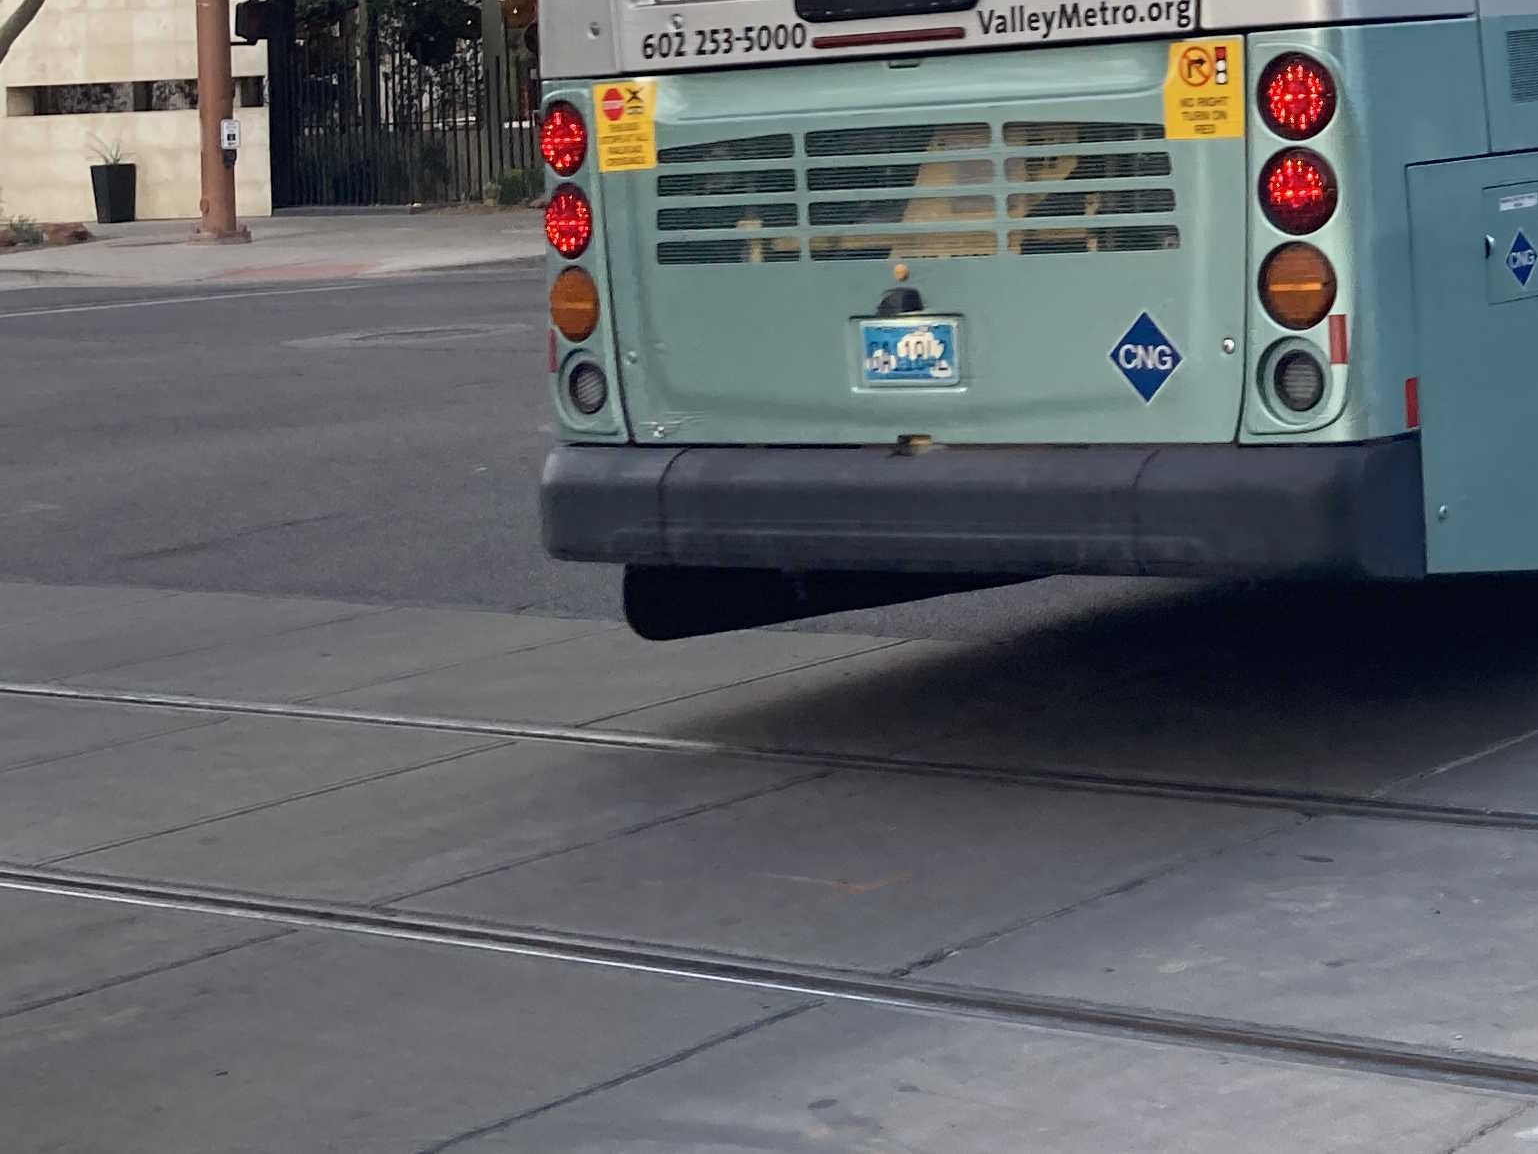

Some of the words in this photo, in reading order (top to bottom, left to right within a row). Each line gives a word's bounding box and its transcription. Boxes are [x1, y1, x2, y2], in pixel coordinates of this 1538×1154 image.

[642, 32, 687, 60] 602
[694, 22, 807, 56] 253-5000
[1509, 249, 1536, 269] CNG
[1118, 343, 1173, 371] CNG
